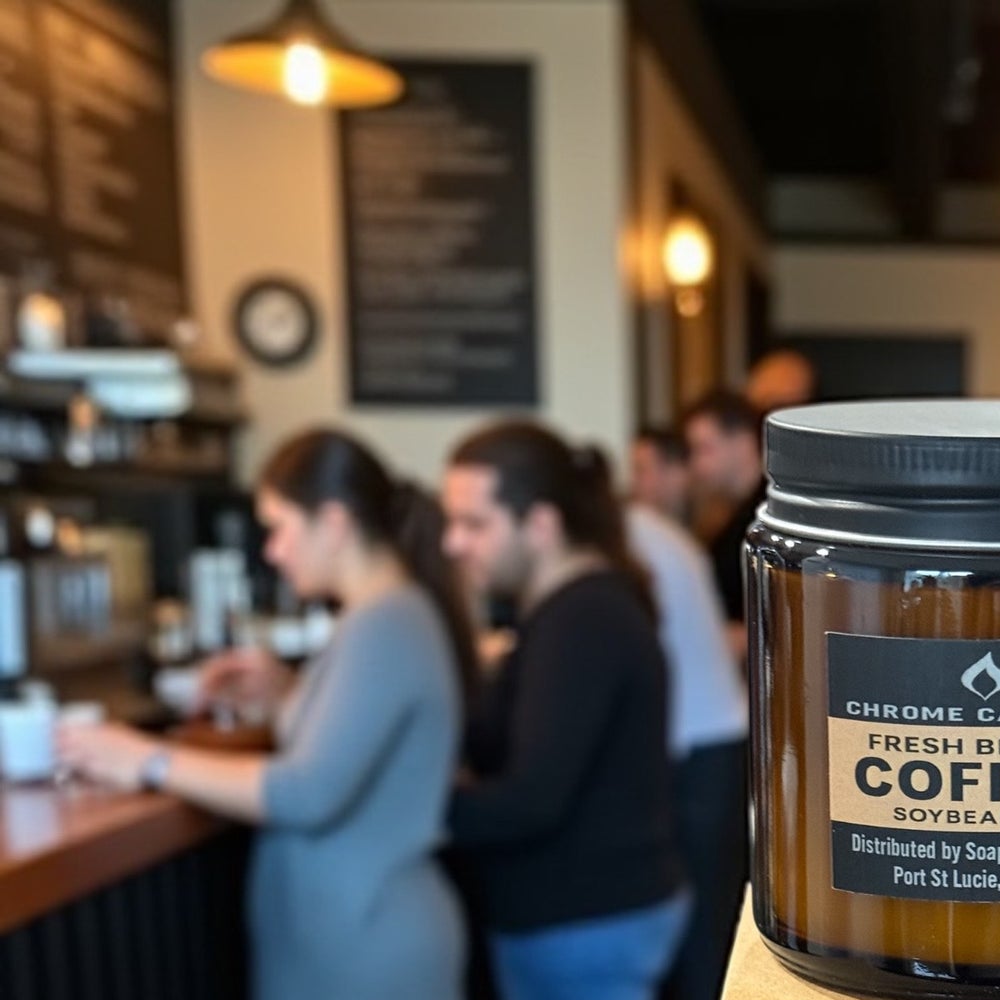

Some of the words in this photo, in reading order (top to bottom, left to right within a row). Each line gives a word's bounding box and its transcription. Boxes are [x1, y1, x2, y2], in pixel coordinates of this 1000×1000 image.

[846, 701, 964, 722] CHROME
[868, 733, 963, 755] FRESH
[851, 833, 937, 860] Distributed
[942, 841, 961, 864] by
[893, 866, 926, 887] Port
[930, 869, 949, 888] St
